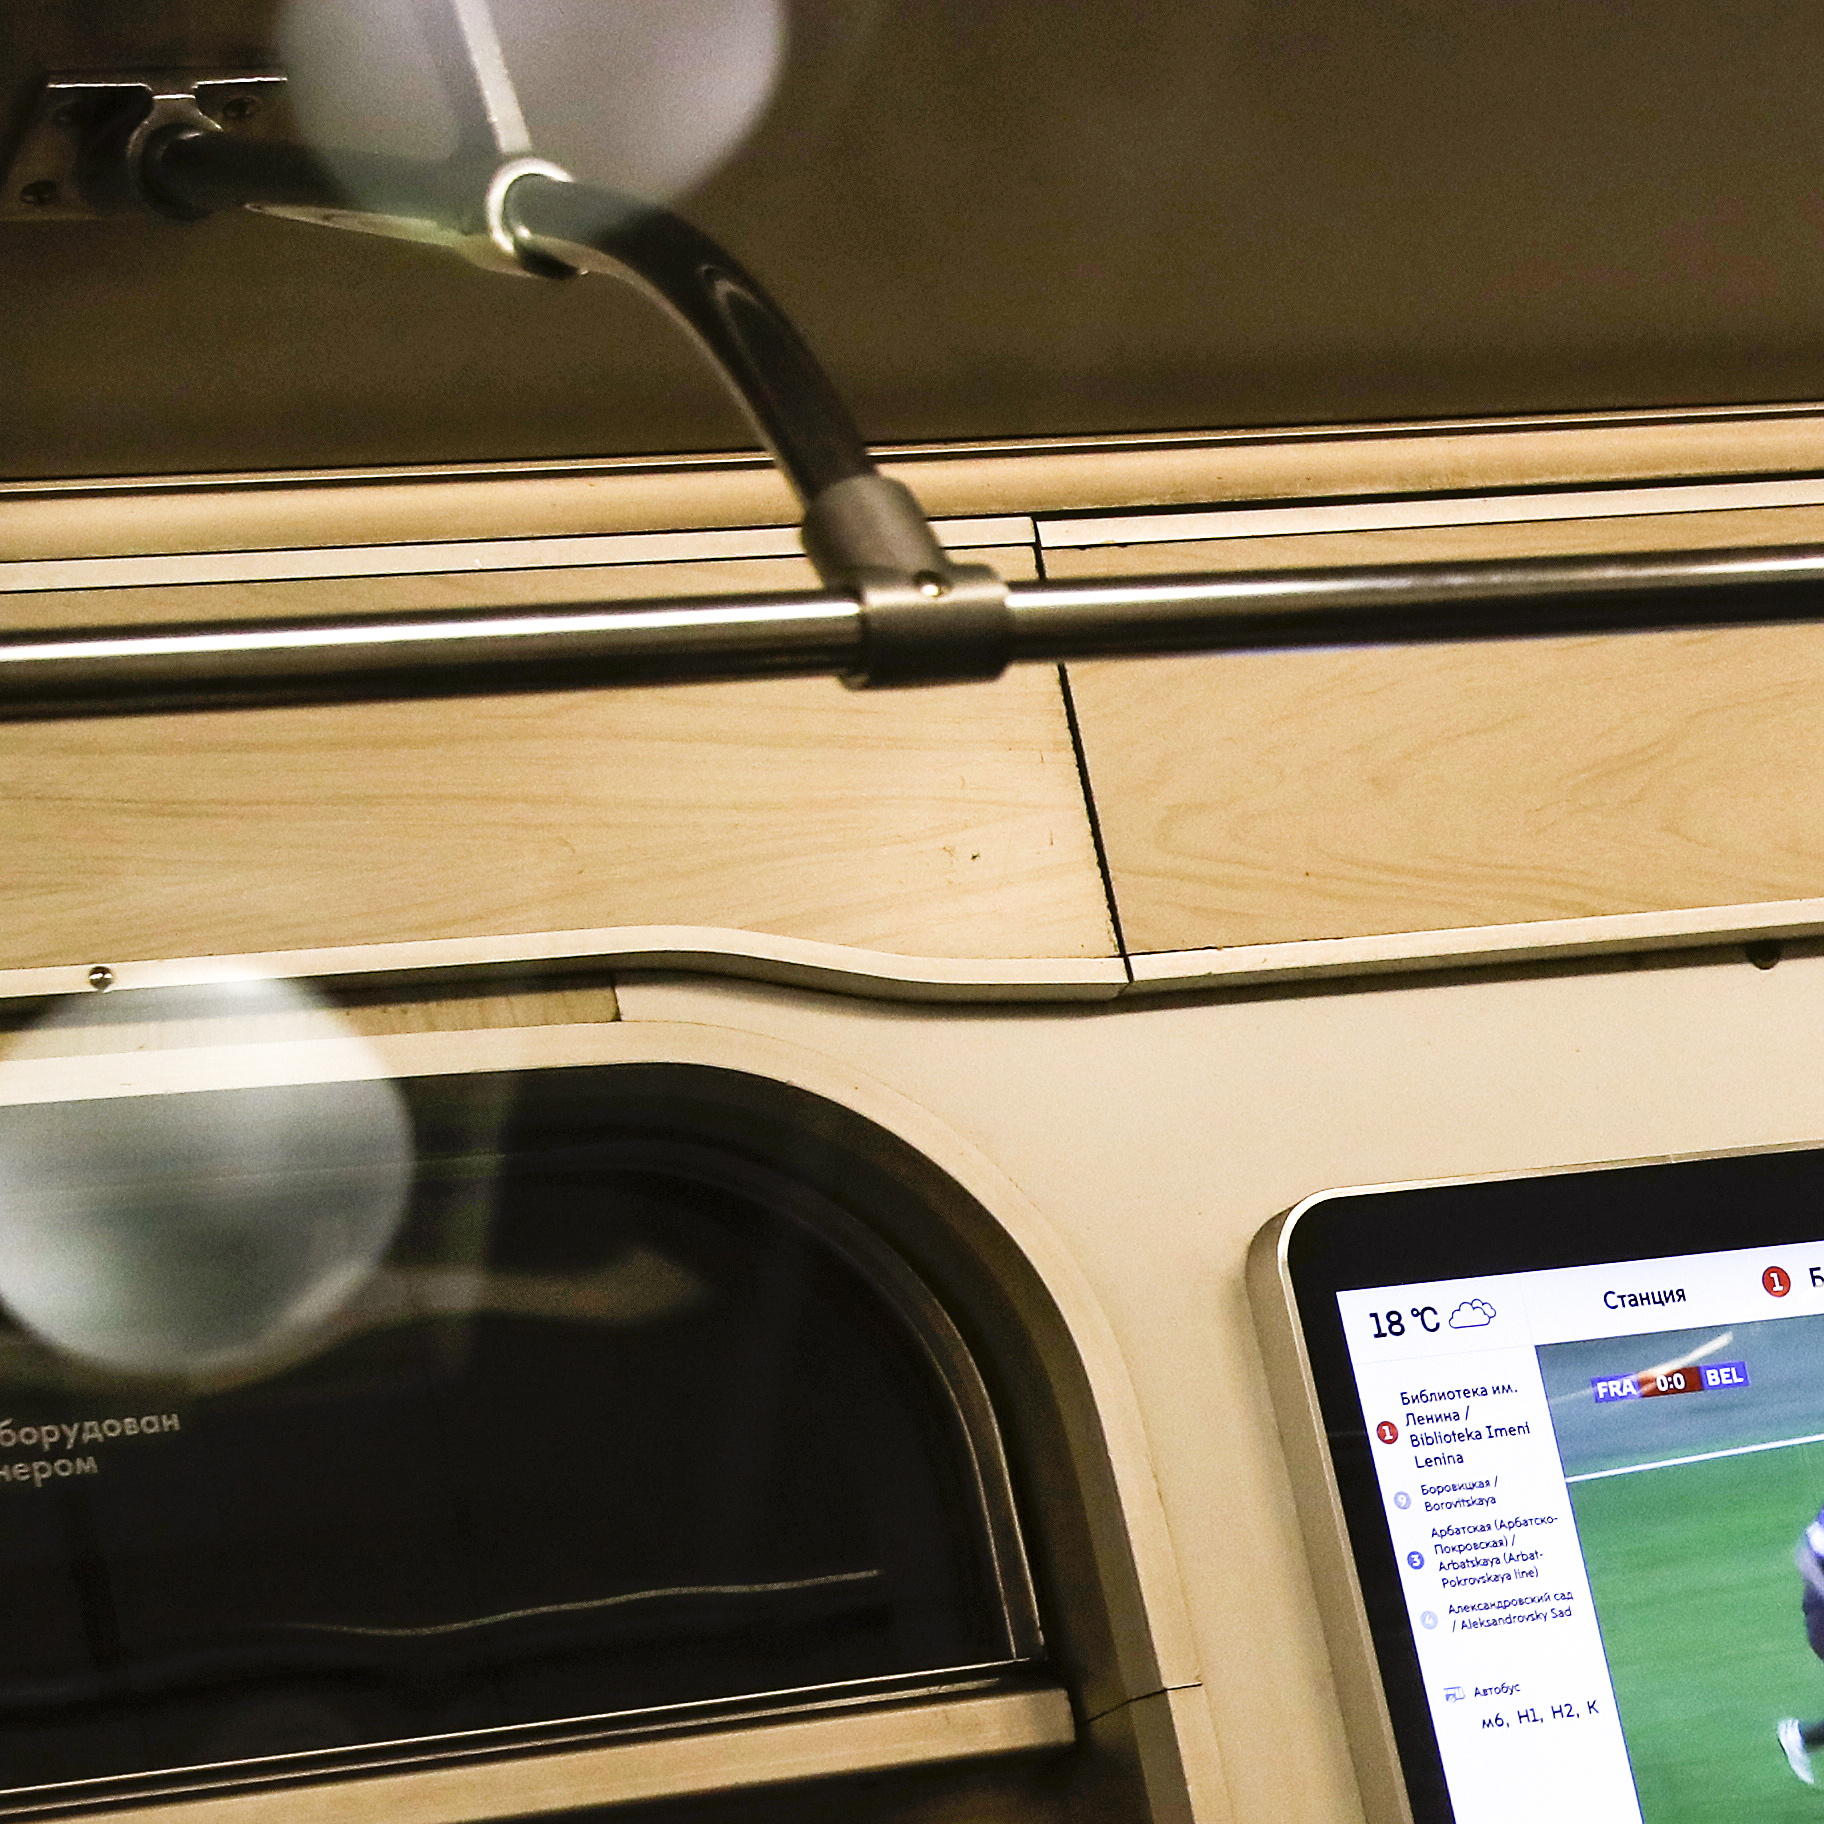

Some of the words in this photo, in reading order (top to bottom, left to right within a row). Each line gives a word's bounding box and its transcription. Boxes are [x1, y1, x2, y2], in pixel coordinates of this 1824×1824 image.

[1769, 1272, 1784, 1292] 1
[1603, 1287, 1687, 1310] Станция
[1369, 1311, 1406, 1338] 18
[1596, 1376, 1638, 1399] FRA
[1655, 1372, 1687, 1393] 0:0
[1706, 1365, 1745, 1388] BEL
[1400, 1385, 1489, 1406] Библиотека
[1491, 1383, 1519, 1395] им.
[1405, 1409, 1461, 1427] Ленина
[1381, 1425, 1394, 1441] 1
[1409, 1426, 1483, 1448] Biblioteka
[1485, 1421, 1531, 1440] Imeni
[1414, 1452, 1465, 1469] Lenina
[1420, 1479, 1491, 1497] Боровицкая
[1424, 1495, 1497, 1512] Borovitskaya
[1431, 1522, 1493, 1539] Арбатская
[1494, 1515, 1559, 1531] (Арбатско-
[1433, 1535, 1509, 1556] Покровская)
[1411, 1553, 1421, 1567] 3
[1438, 1555, 1501, 1572] Arbatskaya
[1503, 1550, 1544, 1564] (Arbat-
[1441, 1570, 1512, 1589] Pokrovskaya
[1513, 1565, 1540, 1579] line)
[1447, 1592, 1552, 1615] Александровский
[1553, 1590, 1574, 1601] сад
[1460, 1610, 1548, 1631] Aleksandrovsky
[1550, 1606, 1573, 1619] Sad
[1474, 1682, 1521, 1698] Автобус
[1482, 1712, 1511, 1729] м6,
